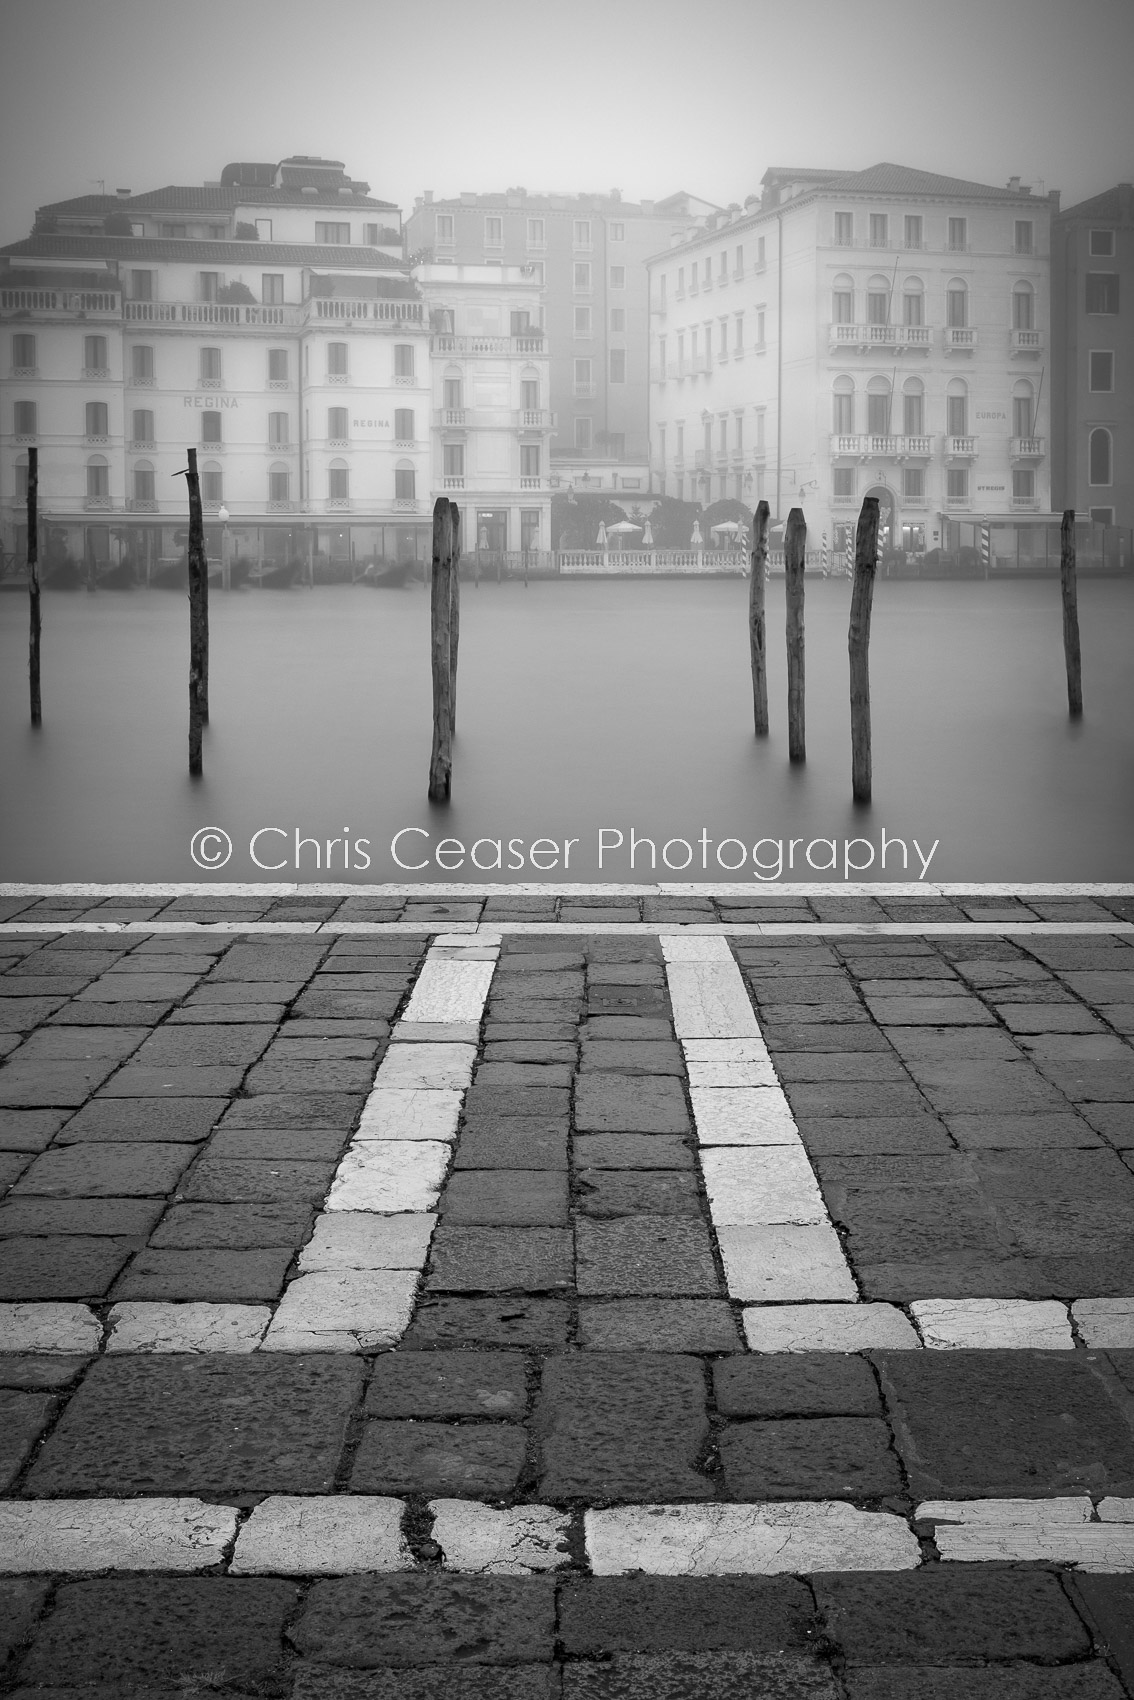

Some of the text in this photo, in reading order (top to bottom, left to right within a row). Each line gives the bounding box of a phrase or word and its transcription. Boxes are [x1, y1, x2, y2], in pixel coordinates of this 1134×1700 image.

[183, 396, 238, 408] REGINA
[975, 411, 1007, 420] EUROPA
[353, 419, 390, 428] REGINA
